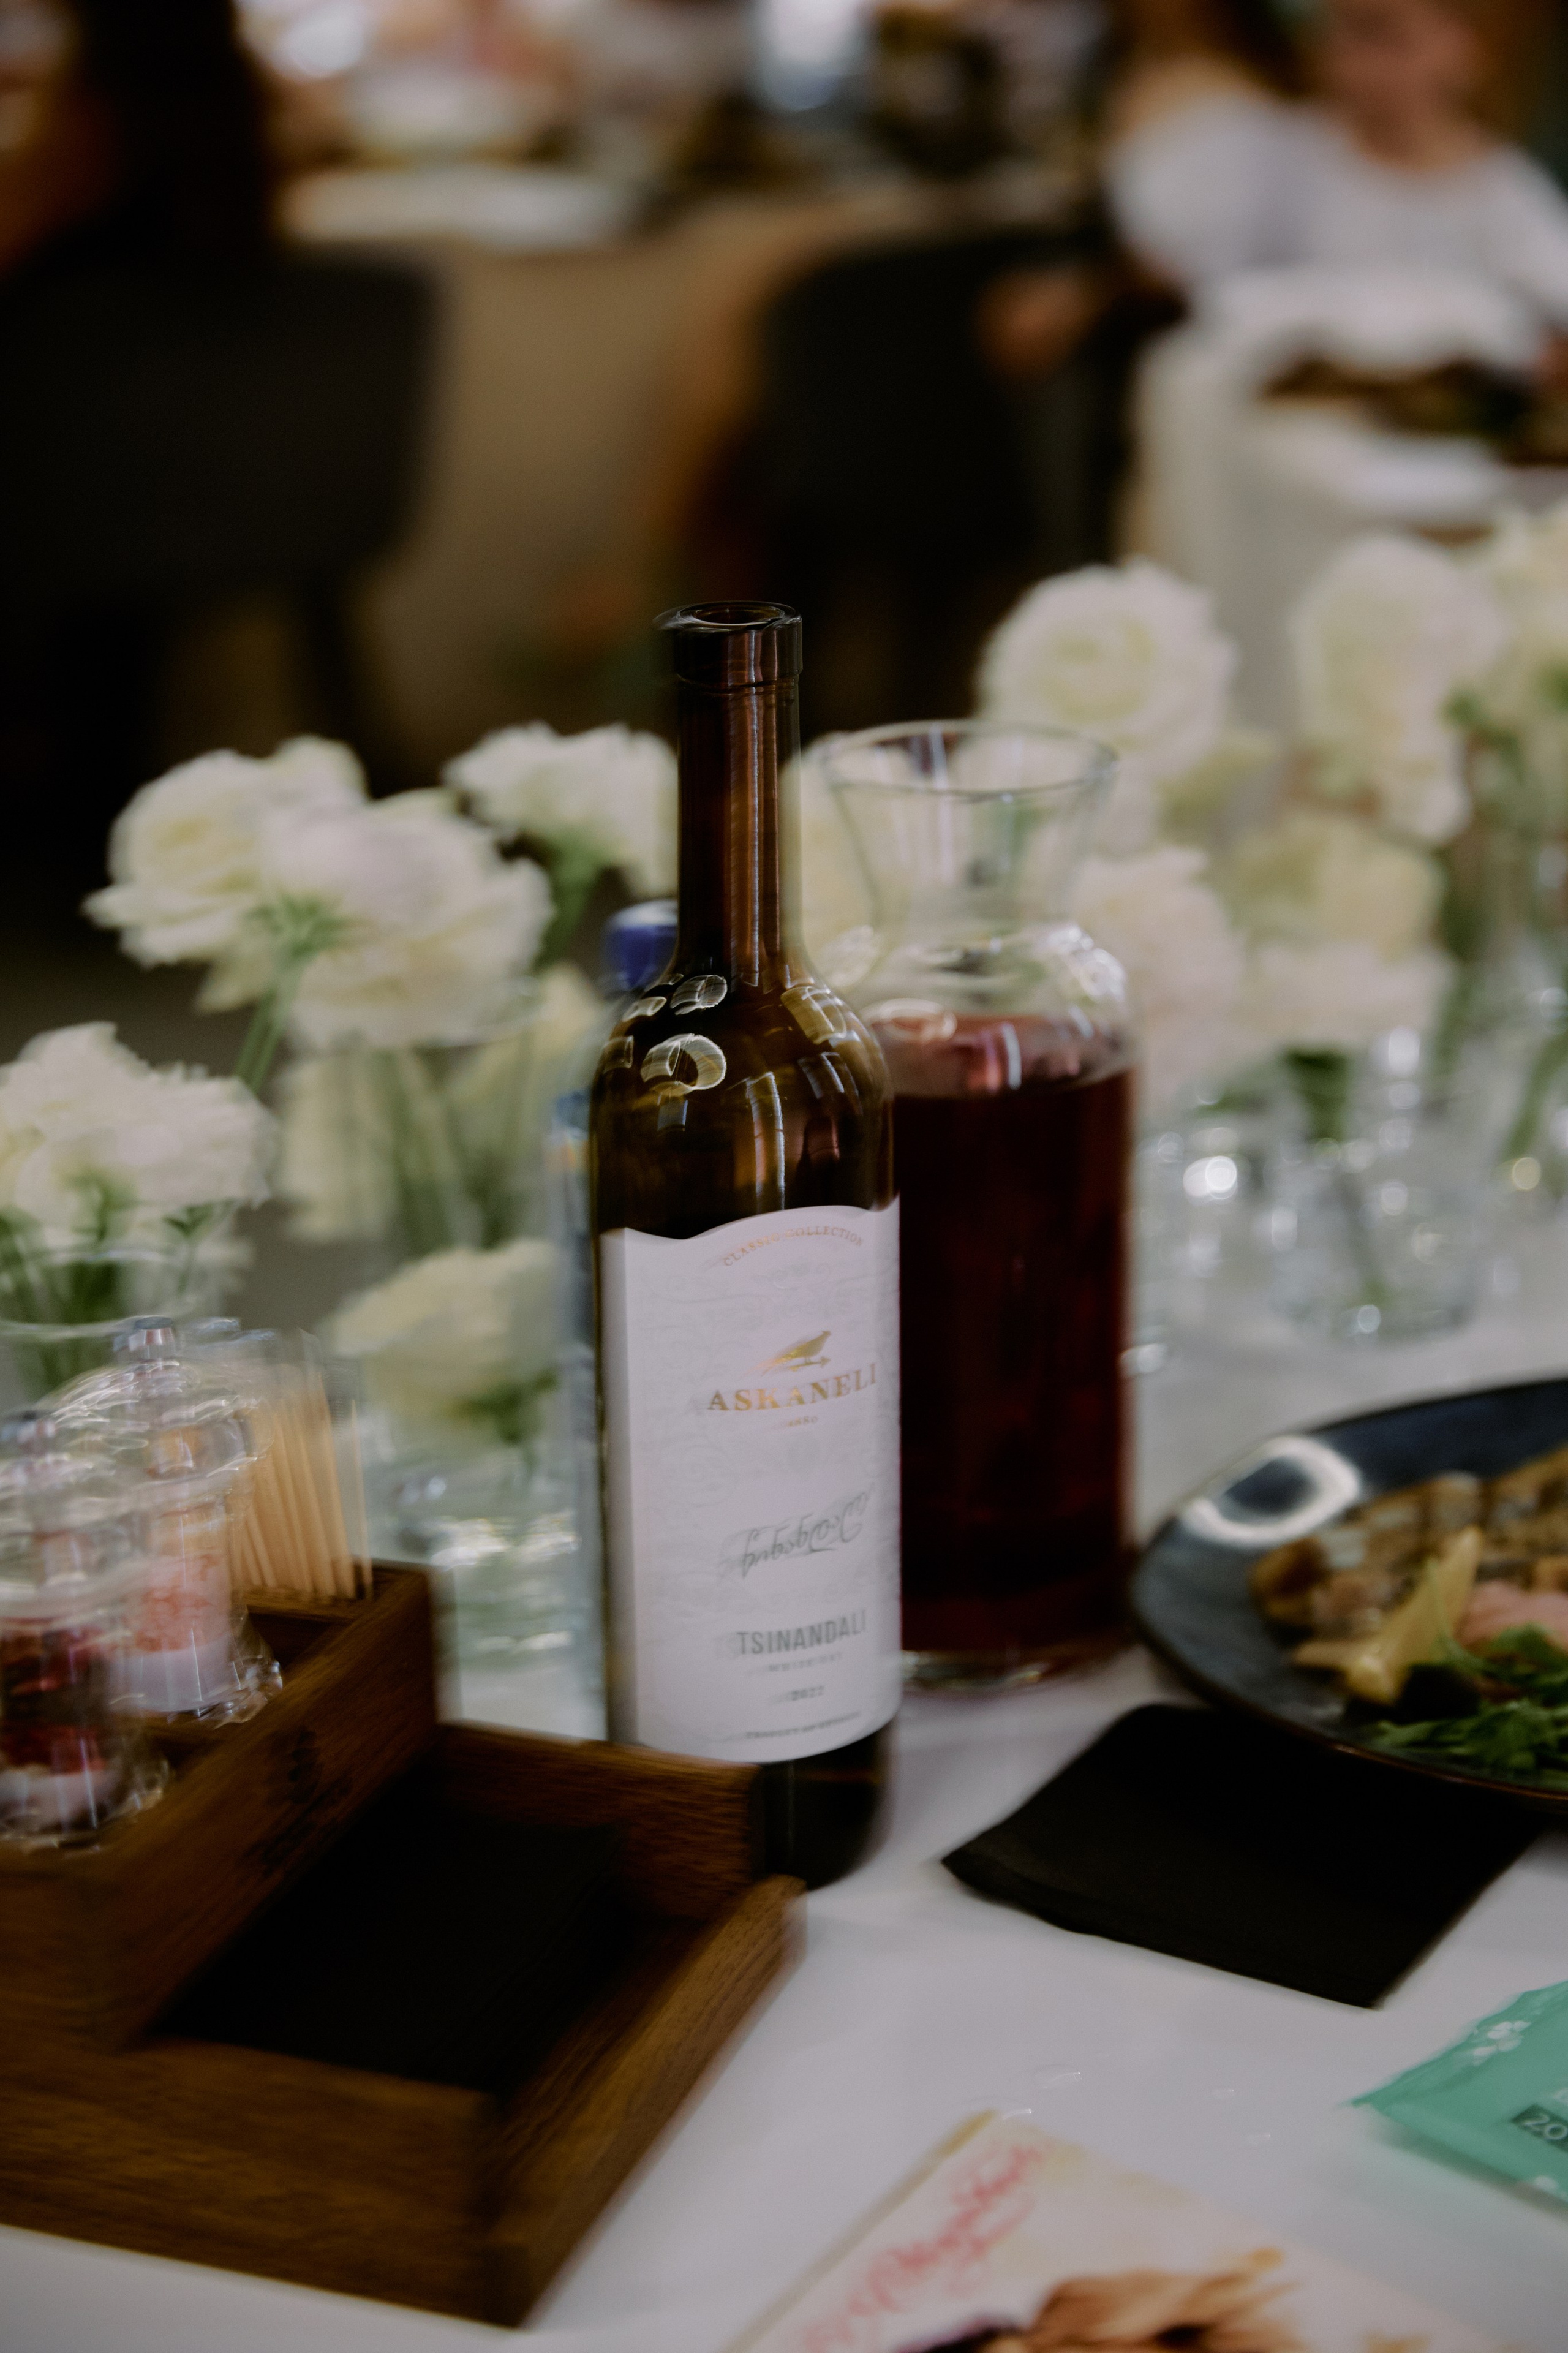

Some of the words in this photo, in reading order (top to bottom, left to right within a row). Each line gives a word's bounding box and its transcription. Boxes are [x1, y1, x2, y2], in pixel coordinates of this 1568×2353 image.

[786, 1225, 864, 1247] COLLECTION
[707, 1363, 877, 1411] ASKANELI
[736, 1609, 866, 1655] TSINANDALI
